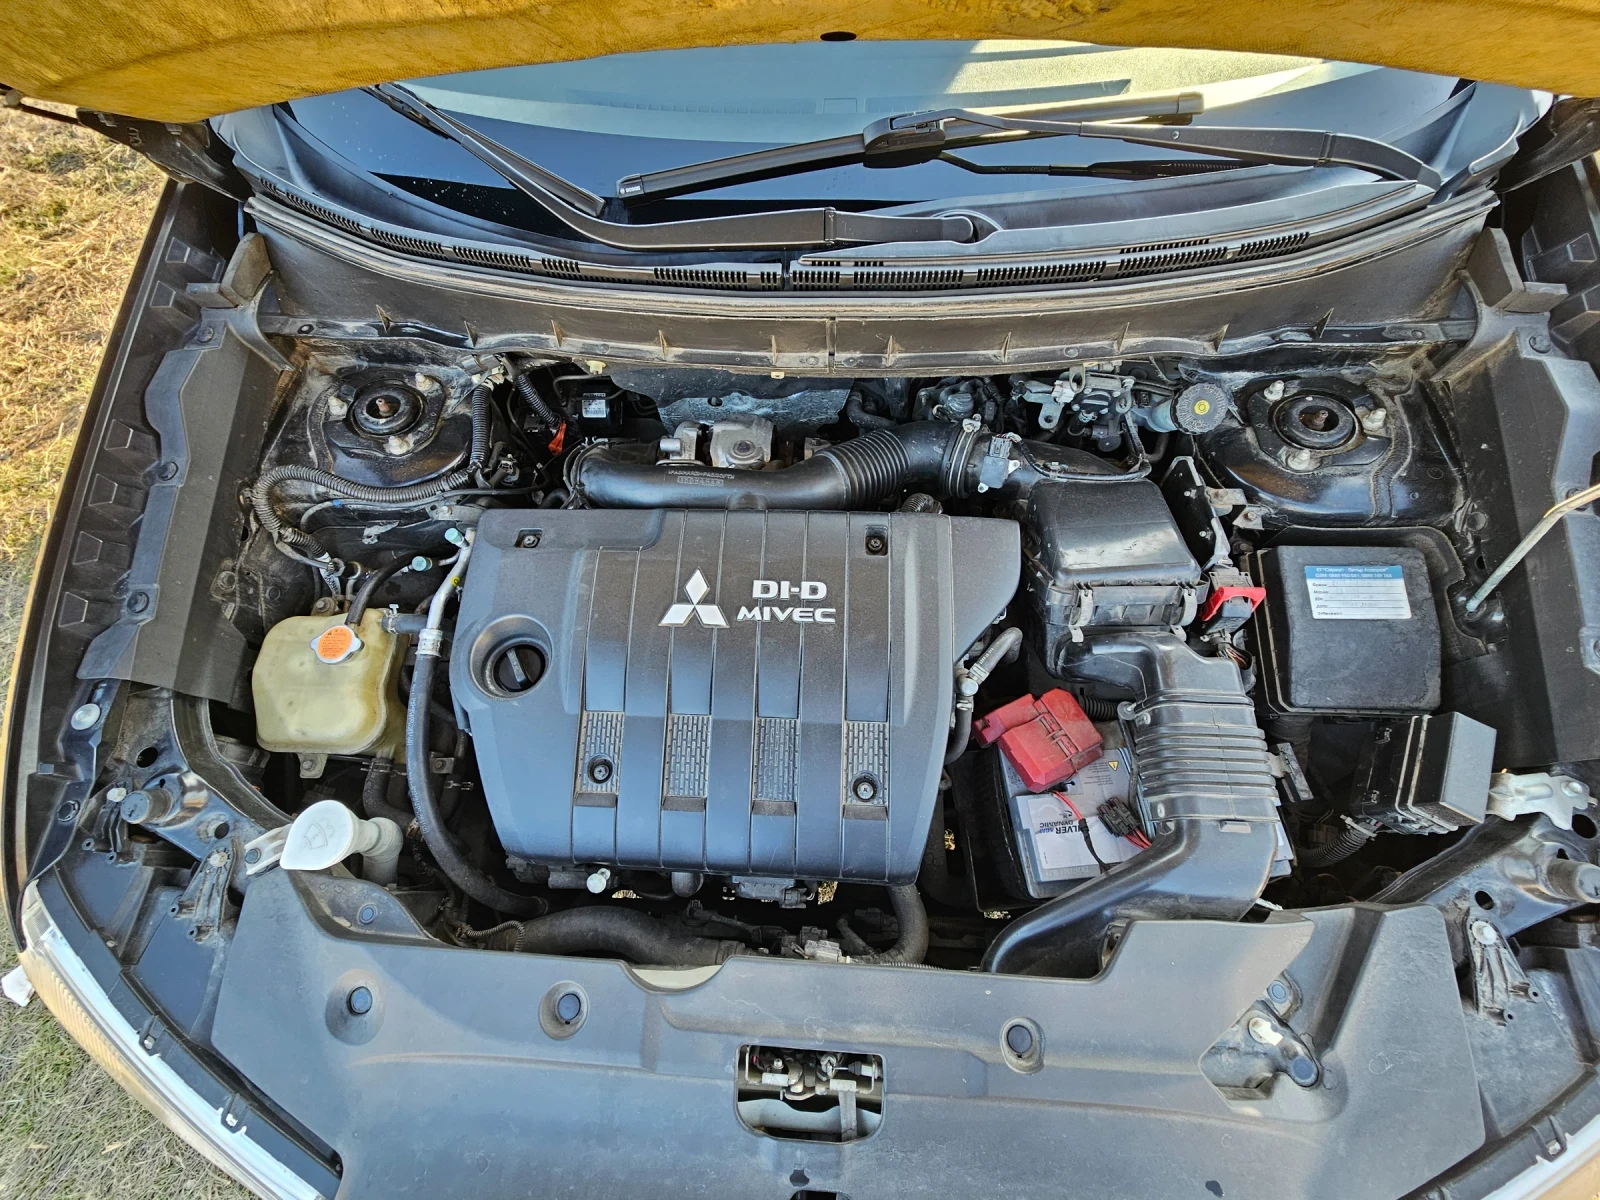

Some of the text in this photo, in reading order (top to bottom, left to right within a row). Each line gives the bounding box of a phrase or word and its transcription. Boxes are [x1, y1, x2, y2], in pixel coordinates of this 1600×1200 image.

[752, 580, 828, 600] DI-D
[736, 605, 836, 624] MIVEC
[1040, 820, 1073, 828] DYNAMIC
[1056, 825, 1080, 834] ILVER
